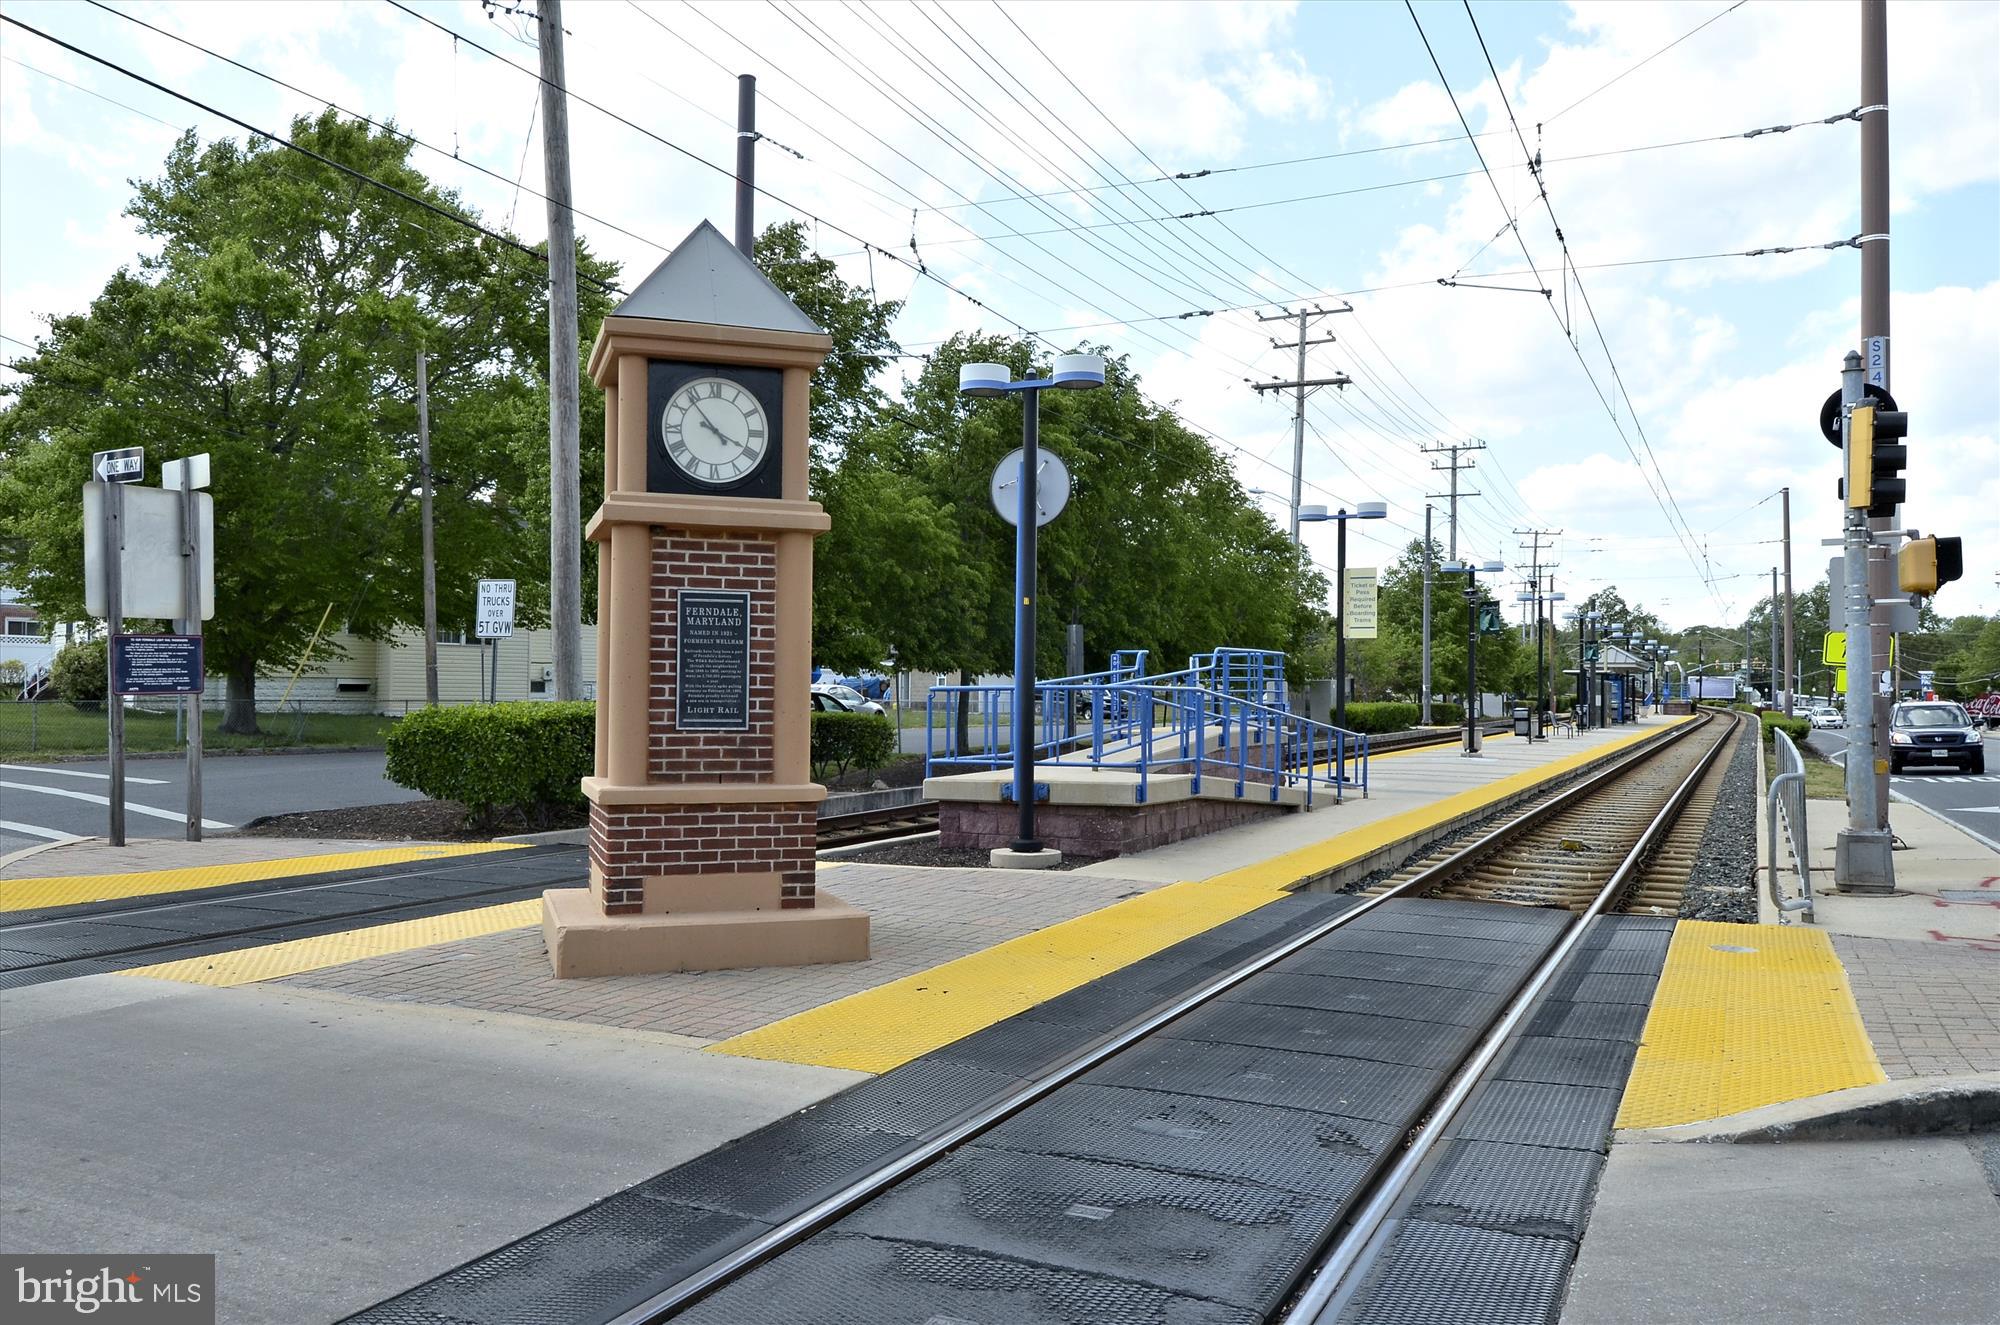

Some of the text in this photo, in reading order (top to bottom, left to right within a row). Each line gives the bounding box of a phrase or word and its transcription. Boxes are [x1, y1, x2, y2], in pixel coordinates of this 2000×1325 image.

[107, 458, 138, 474] ONE WAY
[481, 584, 512, 593] NO THRU
[483, 596, 510, 606] TRUCKS
[686, 607, 742, 617] FERNDALE,
[687, 617, 741, 626] MARYLAND
[479, 621, 511, 634] 5T GVW
